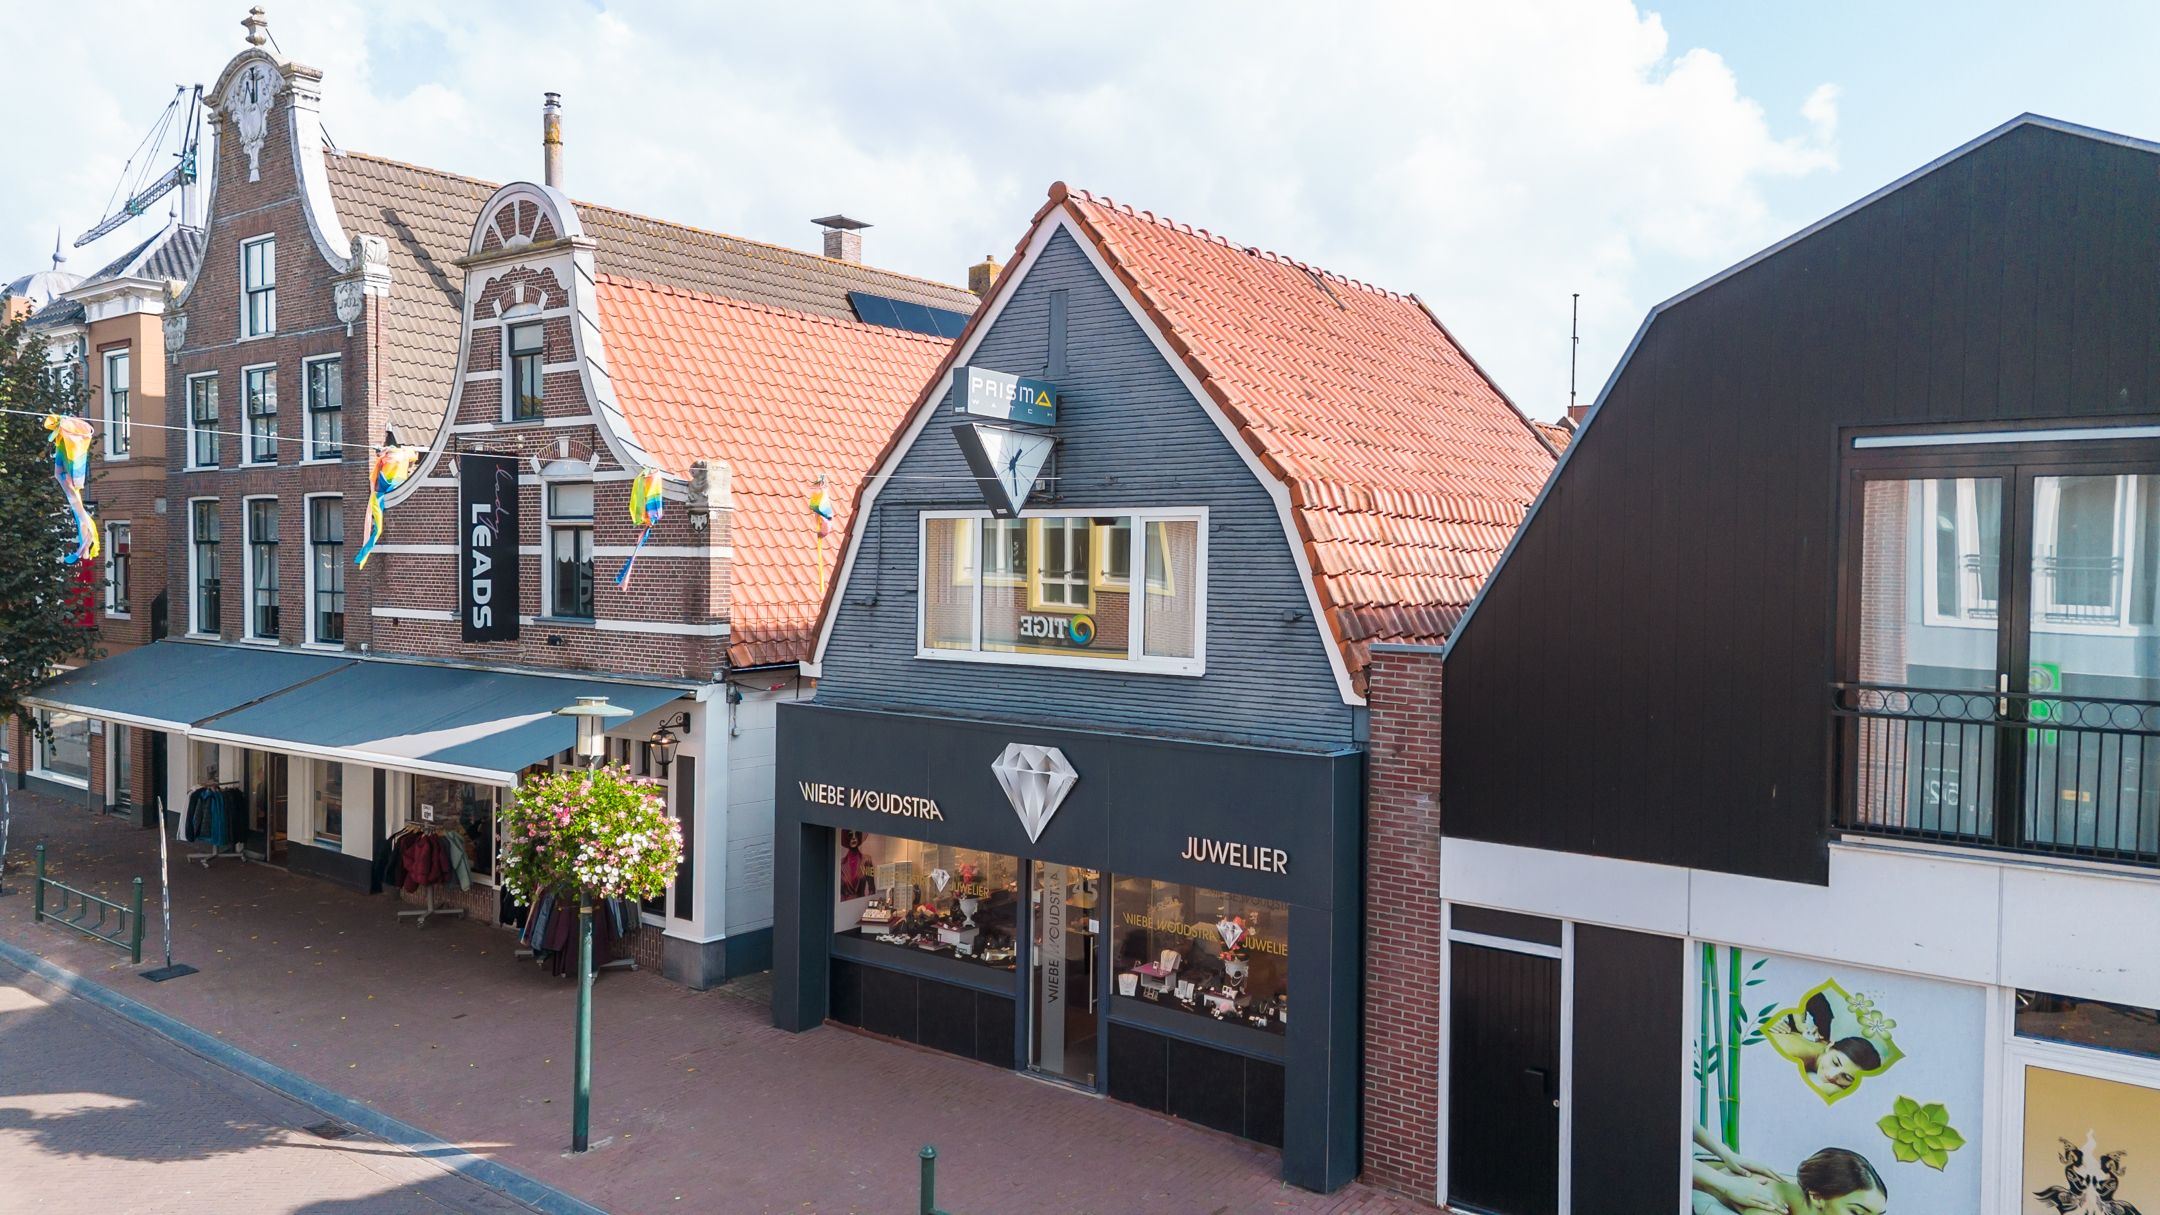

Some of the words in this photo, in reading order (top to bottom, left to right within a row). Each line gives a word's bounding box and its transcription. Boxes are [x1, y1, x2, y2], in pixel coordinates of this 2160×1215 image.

[471, 503, 492, 630] LEADS
[798, 781, 846, 807] WIEBE
[849, 788, 944, 822] WOUDSTRA
[1181, 836, 1288, 875] JUWELIER
[1122, 911, 1153, 929] WIEBE
[1155, 919, 1219, 942] WOUDSTRA
[1242, 934, 1289, 957] JUWELIE
[1048, 959, 1060, 1004] WIEBE
